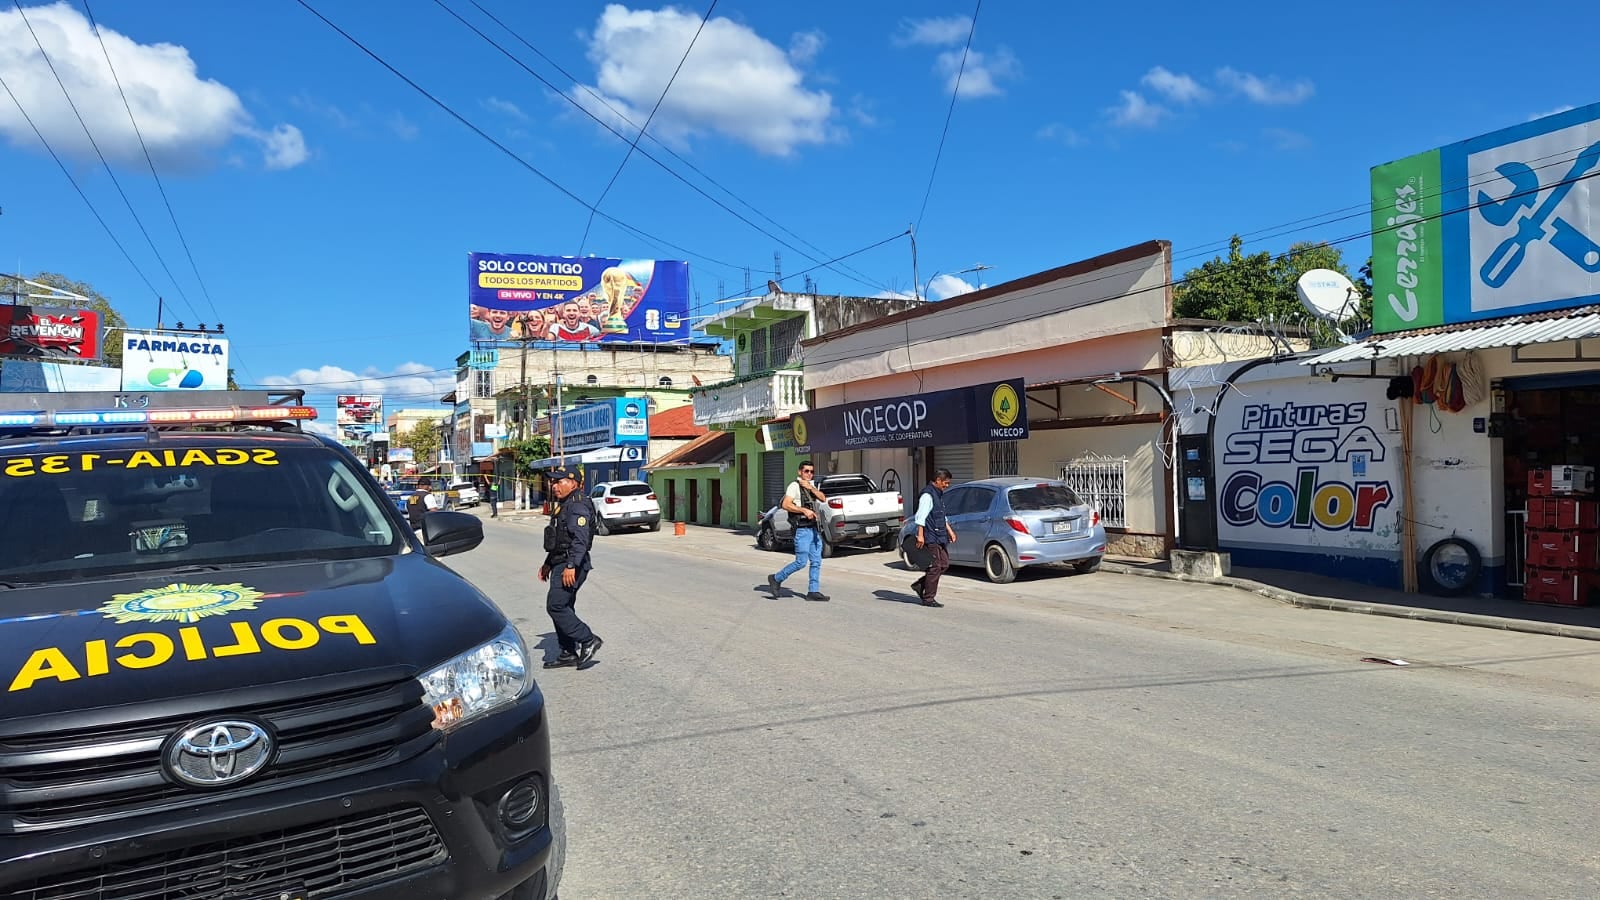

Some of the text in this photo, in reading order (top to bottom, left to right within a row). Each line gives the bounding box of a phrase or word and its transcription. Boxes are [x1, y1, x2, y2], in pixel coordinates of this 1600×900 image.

[1388, 183, 1426, 323] Cerrajes
[478, 260, 583, 274] SOLO CON TIGO
[484, 276, 578, 287] TODOS LOS PARTIDOS
[40, 318, 51, 326] EL
[10, 323, 83, 339] REVENTÓN
[127, 340, 224, 355] FARMACIA
[844, 401, 927, 437] INGECOP
[1241, 402, 1367, 430] Pinturas
[990, 427, 1024, 437] INGECOP
[1222, 426, 1386, 464] SEGA
[1220, 466, 1394, 532] Color
